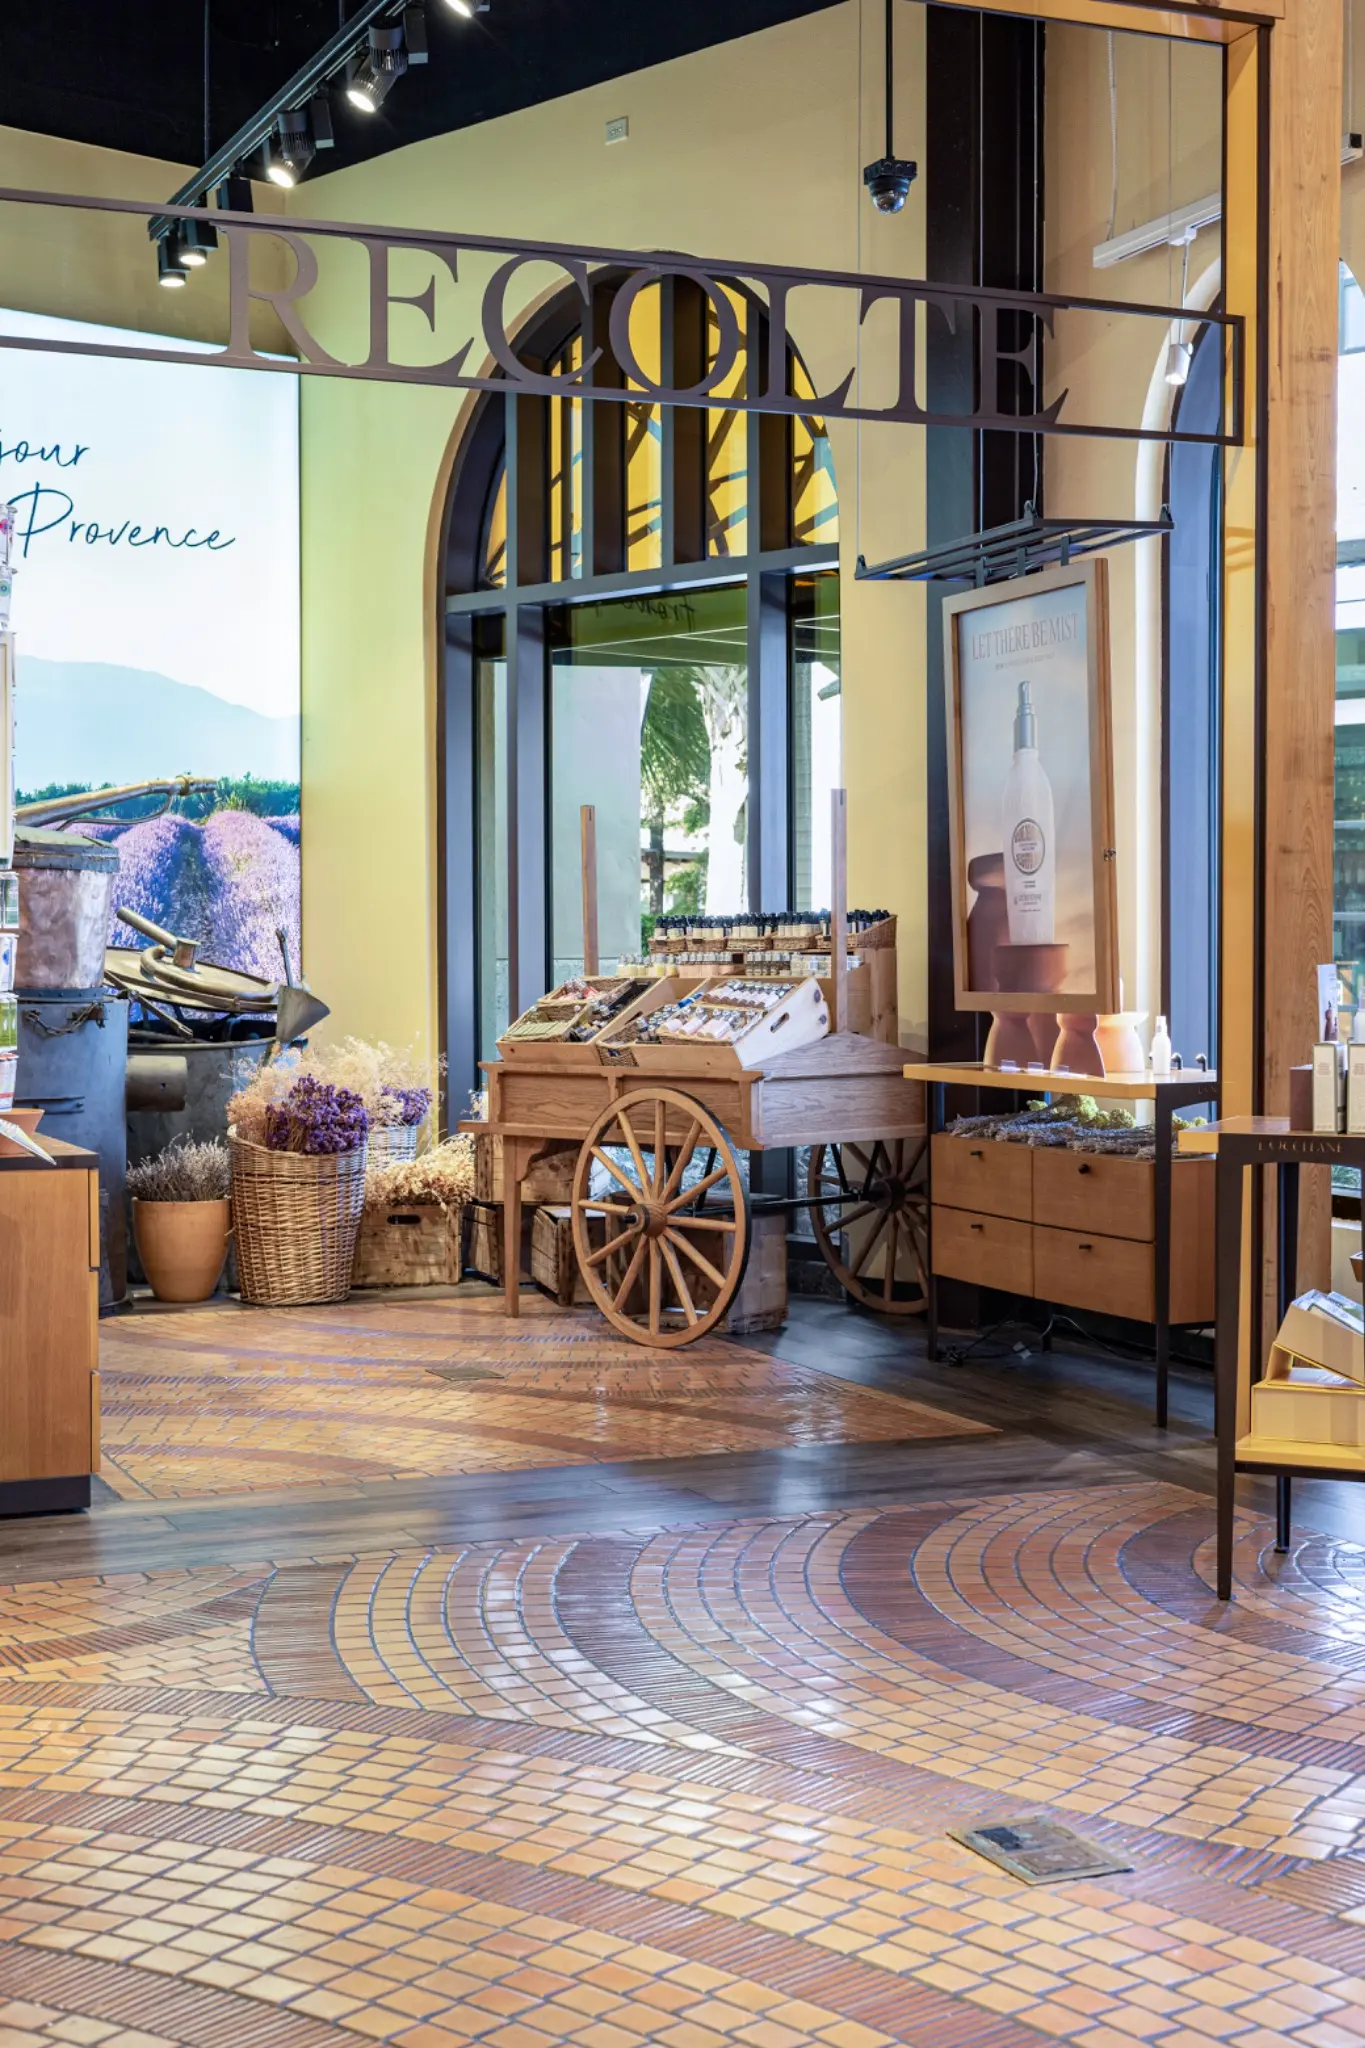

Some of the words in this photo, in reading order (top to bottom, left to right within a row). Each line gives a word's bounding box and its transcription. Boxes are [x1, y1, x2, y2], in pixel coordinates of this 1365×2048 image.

[215, 226, 1069, 424] RECOLTE
[0, 439, 89, 467] our
[7, 481, 236, 558] Provence
[972, 632, 992, 660] LET
[993, 622, 1030, 656] THERE
[1031, 620, 1049, 648] BE
[1049, 612, 1078, 644] MIST
